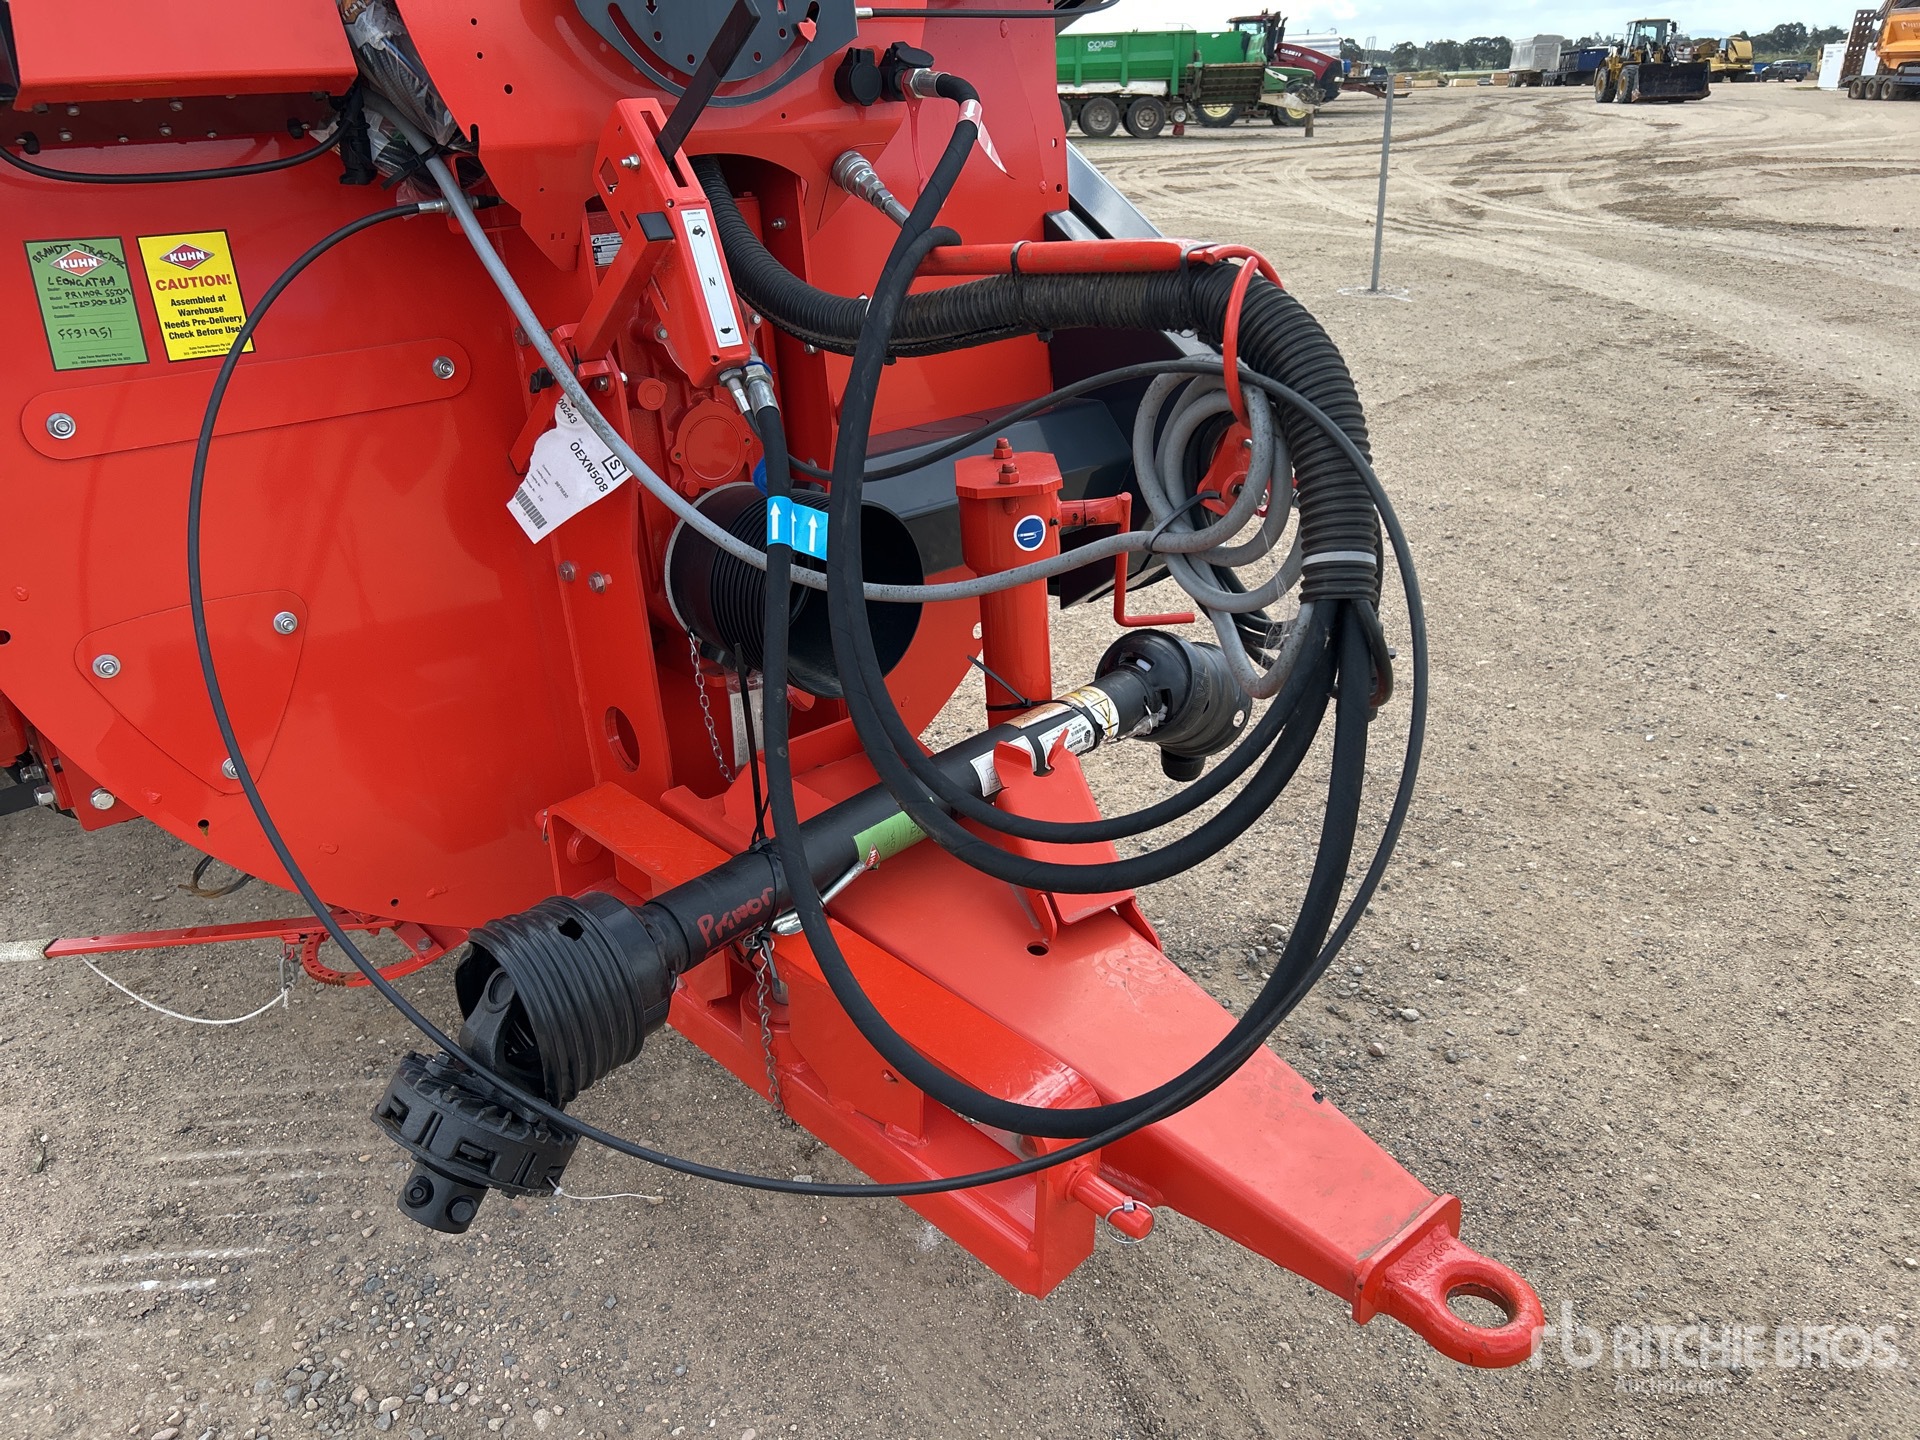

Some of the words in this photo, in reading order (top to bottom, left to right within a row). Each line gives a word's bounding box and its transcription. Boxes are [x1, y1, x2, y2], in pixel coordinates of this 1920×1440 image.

[32, 244, 71, 264] BRANDT
[79, 243, 125, 269] TRACTOR
[169, 251, 206, 262] KUHN
[59, 258, 98, 269] KUHN
[155, 273, 232, 291] CAUTION!
[708, 277, 717, 287] N
[65, 289, 103, 299] PRIMOR
[171, 294, 216, 307] Assembled
[217, 293, 227, 302] at
[177, 306, 224, 317] Warehouse
[164, 320, 190, 329] Needs
[192, 315, 242, 327] Pre-Delivery
[168, 330, 195, 340] Check
[196, 327, 224, 337] Before
[610, 459, 621, 470] S
